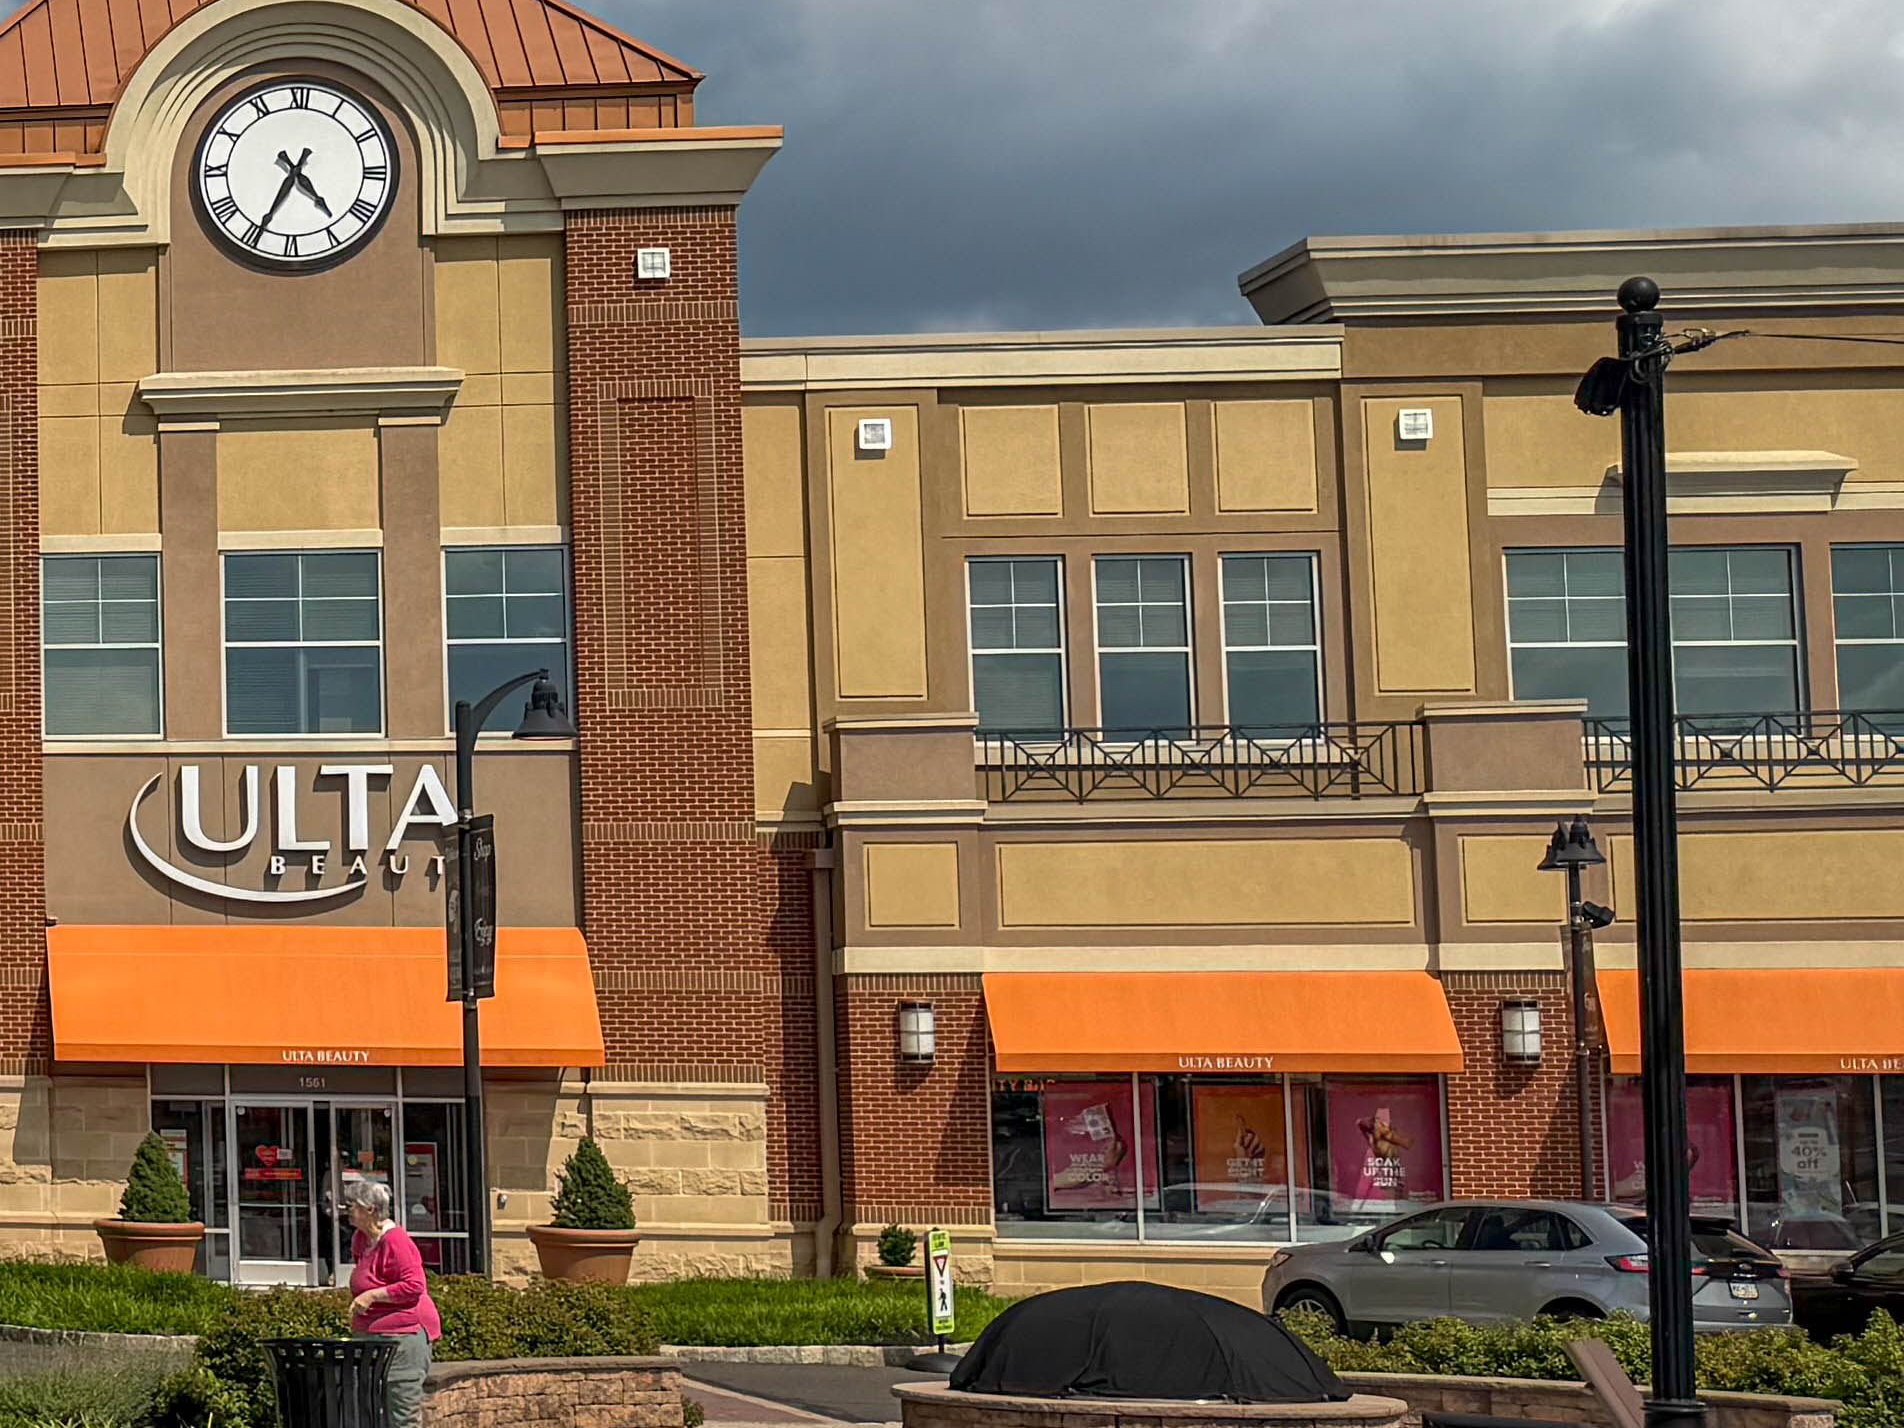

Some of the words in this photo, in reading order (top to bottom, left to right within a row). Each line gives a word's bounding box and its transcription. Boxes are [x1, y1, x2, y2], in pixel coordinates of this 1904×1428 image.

[181, 764, 459, 852] ULTA
[270, 855, 446, 875] BEAUT
[282, 1050, 314, 1062] ULTA
[317, 1050, 370, 1062] BEAUTY
[1178, 1055, 1213, 1068] ULTA
[1216, 1056, 1274, 1069] BEAUTY
[1840, 1057, 1879, 1070] ULTA
